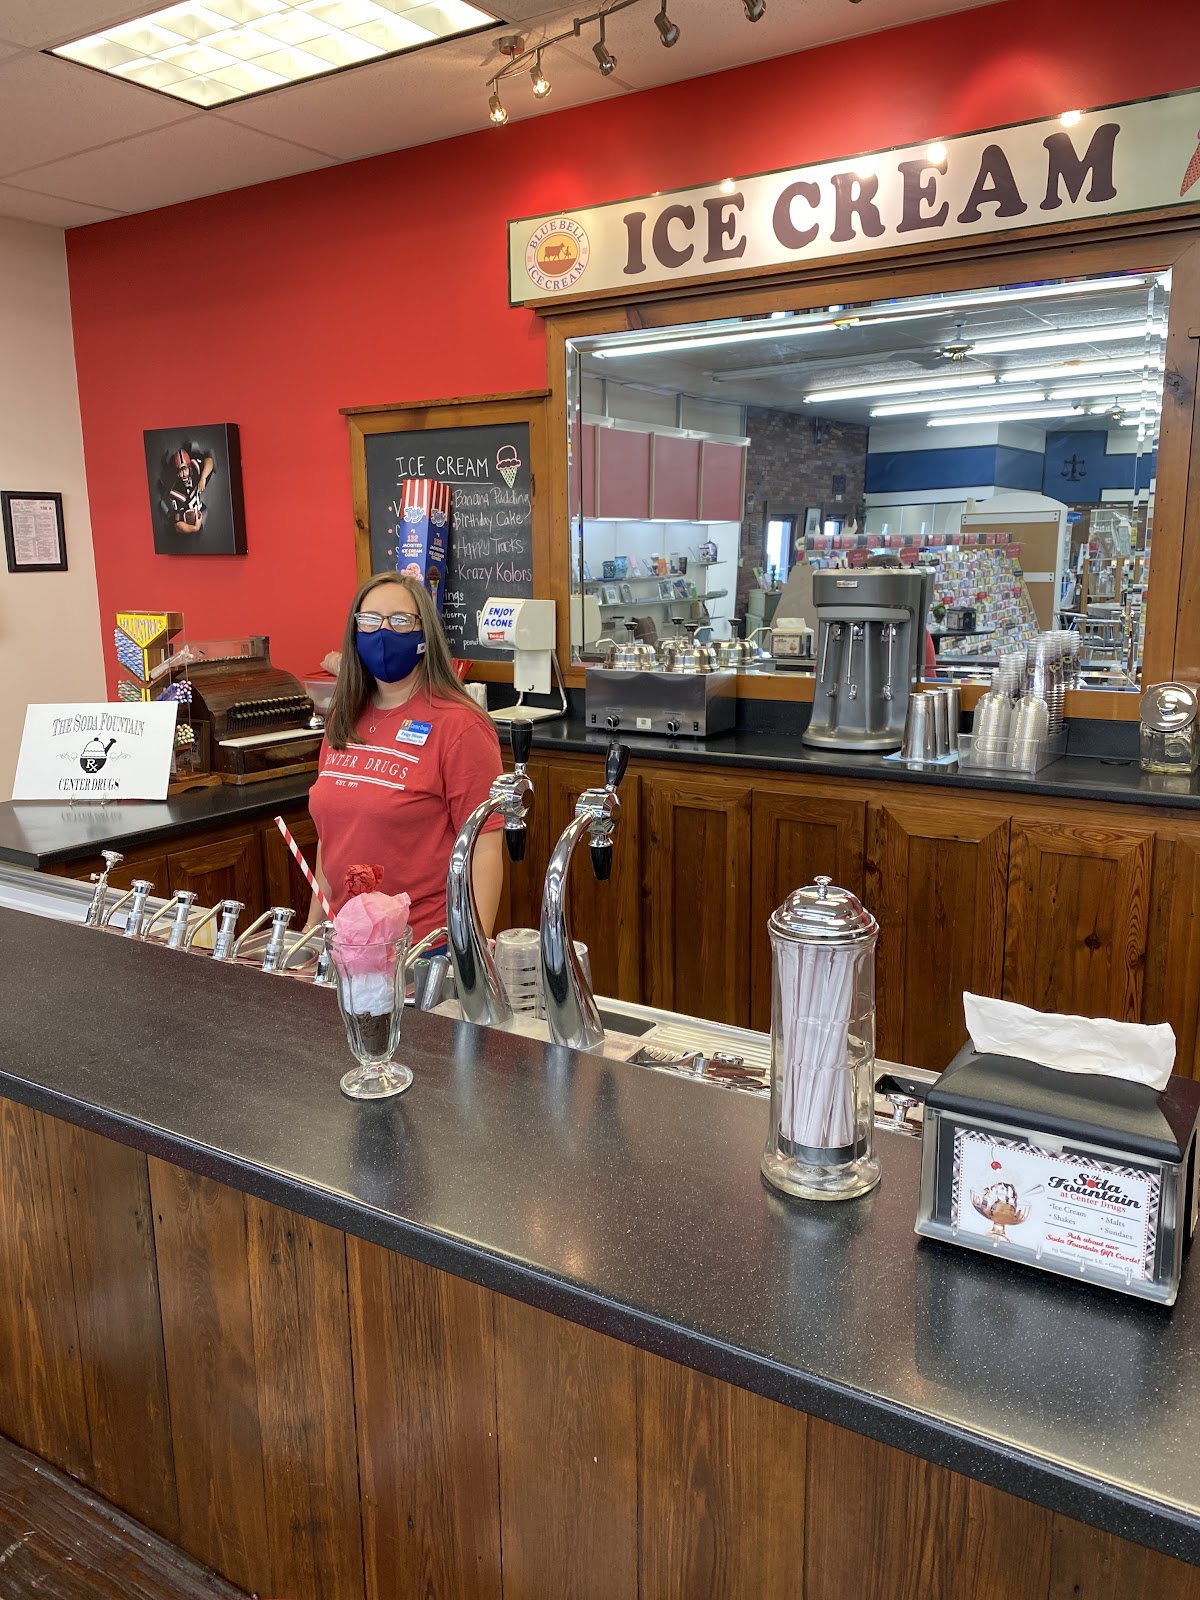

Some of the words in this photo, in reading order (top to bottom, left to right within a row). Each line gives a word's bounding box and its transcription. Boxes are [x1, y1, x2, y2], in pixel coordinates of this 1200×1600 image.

[623, 192, 747, 274] ICE
[772, 123, 1121, 250] CREAM
[529, 221, 557, 249] BLUE
[559, 220, 585, 243] BELL
[528, 265, 545, 285] ICE
[545, 262, 585, 290] CREAM
[396, 456, 426, 477] ICE
[436, 455, 489, 478] CREAM
[496, 510, 524, 527] Cake
[457, 536, 490, 559] Happy
[457, 562, 493, 590] Krazy
[496, 561, 533, 582] Kolors
[488, 607, 515, 618] ENJOY
[490, 618, 513, 627] CONE
[52, 718, 73, 737] THE
[73, 713, 98, 733] SODA
[99, 712, 146, 737] FOUNTAIN
[325, 753, 358, 768] ENTER
[364, 757, 409, 779] DRUGS
[58, 778, 91, 791] CENTER
[91, 778, 121, 791] DRUGS
[1048, 1176, 1142, 1209] Fountain
[1060, 1191, 1069, 1199] at
[1070, 1193, 1100, 1206] Center
[1101, 1200, 1126, 1213] Drugs
[1052, 1203, 1063, 1212] Ice
[1063, 1206, 1087, 1218] Cream
[1053, 1213, 1076, 1225] Shakes
[1105, 1217, 1126, 1228] Malts
[1066, 1232, 1082, 1241] Ask
[1083, 1237, 1104, 1247] about
[1105, 1242, 1119, 1250] our
[1104, 1228, 1133, 1240] Sundaes
[1046, 1234, 1065, 1244] Soda
[1066, 1239, 1099, 1254] Fountain
[1100, 1248, 1114, 1258] Gift
[1115, 1253, 1141, 1265] Cards!
